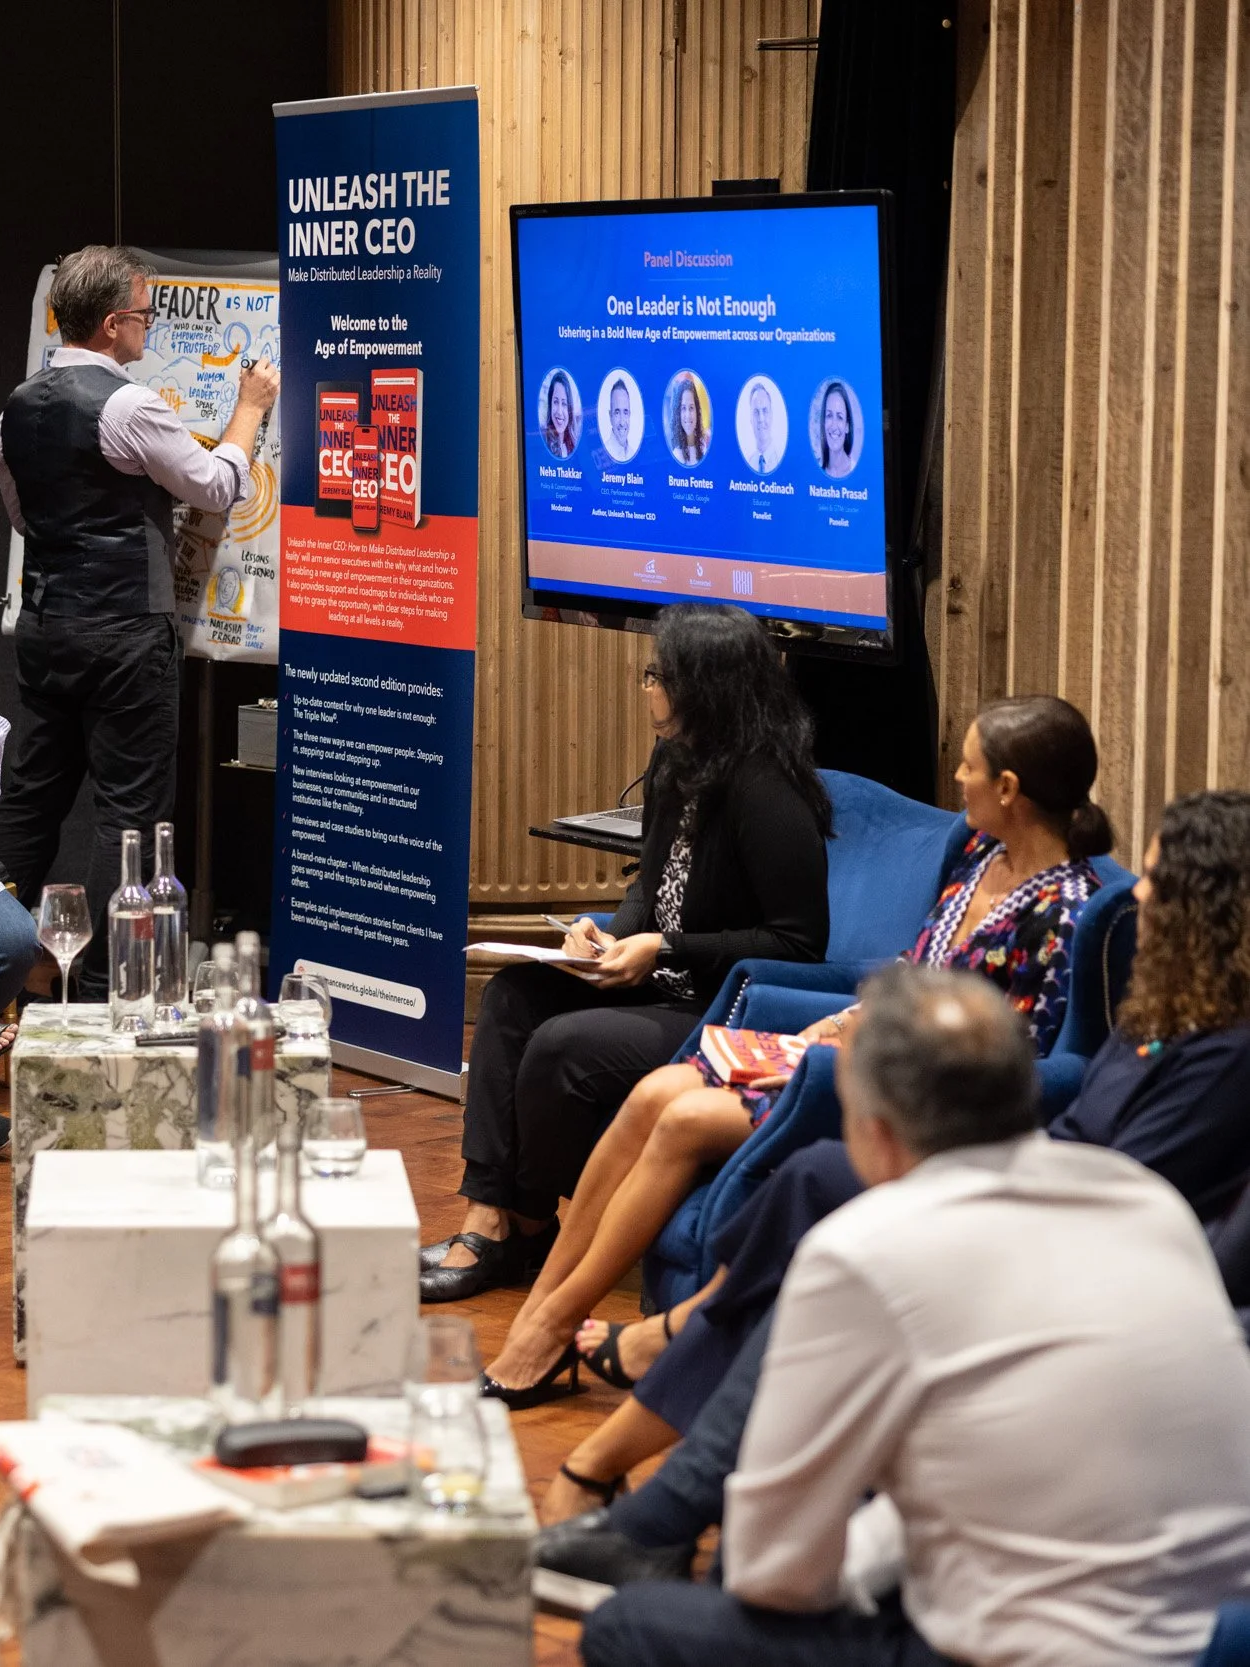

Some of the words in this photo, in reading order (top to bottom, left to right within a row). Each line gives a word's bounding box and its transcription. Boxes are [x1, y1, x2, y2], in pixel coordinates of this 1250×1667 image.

[289, 173, 397, 213] UNLEASH
[402, 169, 450, 207] THE
[289, 221, 359, 257] INNER
[365, 217, 416, 255] CEO
[644, 250, 673, 267] Panel
[675, 250, 733, 267] Discussion
[288, 268, 308, 282] Make
[310, 266, 356, 281] Distributed
[357, 265, 405, 283] Leadership
[406, 268, 411, 279] a
[413, 264, 442, 283] Reality
[247, 296, 274, 312] NOT
[607, 295, 633, 315] One
[636, 295, 680, 316] Leader
[682, 295, 693, 316] is
[696, 295, 721, 316] Not
[723, 295, 776, 322] Enough
[331, 316, 376, 331] Welcome
[378, 316, 390, 331] to
[391, 314, 408, 331] the
[558, 326, 591, 341] Ushering
[592, 326, 600, 338] in
[600, 329, 606, 338] a
[607, 326, 624, 339] Bold
[625, 326, 644, 339] New
[644, 327, 661, 343] Age
[662, 326, 671, 339] of
[672, 327, 731, 342] Empowerment
[732, 330, 758, 341] across
[758, 331, 774, 341] our
[775, 328, 835, 344] Organizations
[314, 341, 336, 359] Age
[337, 340, 348, 355] of
[349, 340, 422, 359] Empowerment
[371, 394, 417, 412] UNLEASH
[320, 410, 358, 421] UNLEASH
[388, 414, 400, 424] THE
[334, 422, 344, 430] THE
[319, 430, 353, 448] INNE
[379, 425, 416, 453] NNER
[380, 452, 416, 494] EO
[539, 466, 556, 477] Neha
[557, 467, 582, 479] Thakkar
[601, 472, 626, 486] Jeremy
[626, 473, 643, 484] Blain
[353, 479, 378, 498] CEO
[668, 475, 689, 487] Bruna
[690, 476, 713, 490] Fontes
[729, 480, 758, 492] Antonio
[759, 481, 794, 494] Codinach
[809, 485, 840, 498] Natasha
[841, 487, 868, 500] Prasad
[396, 509, 413, 520] BLAIN
[551, 504, 572, 512] Moderator
[591, 508, 607, 517] Author,
[607, 509, 625, 518] Unleash
[625, 510, 634, 519] The
[633, 512, 646, 520] Inner
[645, 512, 656, 521] CEO
[682, 505, 701, 514] Panelist
[753, 511, 772, 521] Panelist
[829, 517, 849, 527] Panelist
[732, 570, 753, 595] 1880
[328, 611, 349, 625] leading
[349, 615, 356, 623] at
[355, 614, 363, 624] all
[363, 615, 381, 626] levels
[381, 618, 386, 626] a
[386, 618, 404, 631] reality.
[285, 664, 296, 677] The
[297, 667, 318, 683] newly
[319, 670, 350, 685] updated
[351, 675, 379, 688] second
[380, 677, 407, 692] edition
[408, 682, 443, 697] provides:
[293, 694, 323, 709] Up-to-date
[323, 701, 344, 714] context
[344, 701, 352, 712] for
[352, 703, 365, 716] why
[365, 707, 377, 715] one
[377, 706, 396, 718] leader
[396, 709, 402, 719] is
[402, 712, 412, 720] not
[412, 713, 436, 726] enough:
[293, 708, 303, 719] The
[304, 709, 320, 722] Triple
[293, 729, 303, 740] The
[303, 731, 319, 742] three
[319, 736, 331, 744] new
[332, 738, 345, 749] ways
[345, 740, 354, 748] we
[354, 741, 366, 750] can
[366, 743, 394, 754] empower
[394, 747, 416, 759] people:
[416, 748, 443, 765] Stepping
[300, 746, 324, 760] stepping
[324, 750, 335, 759] out
[334, 751, 346, 761] and
[346, 754, 371, 767] stepping
[371, 759, 381, 768] up.
